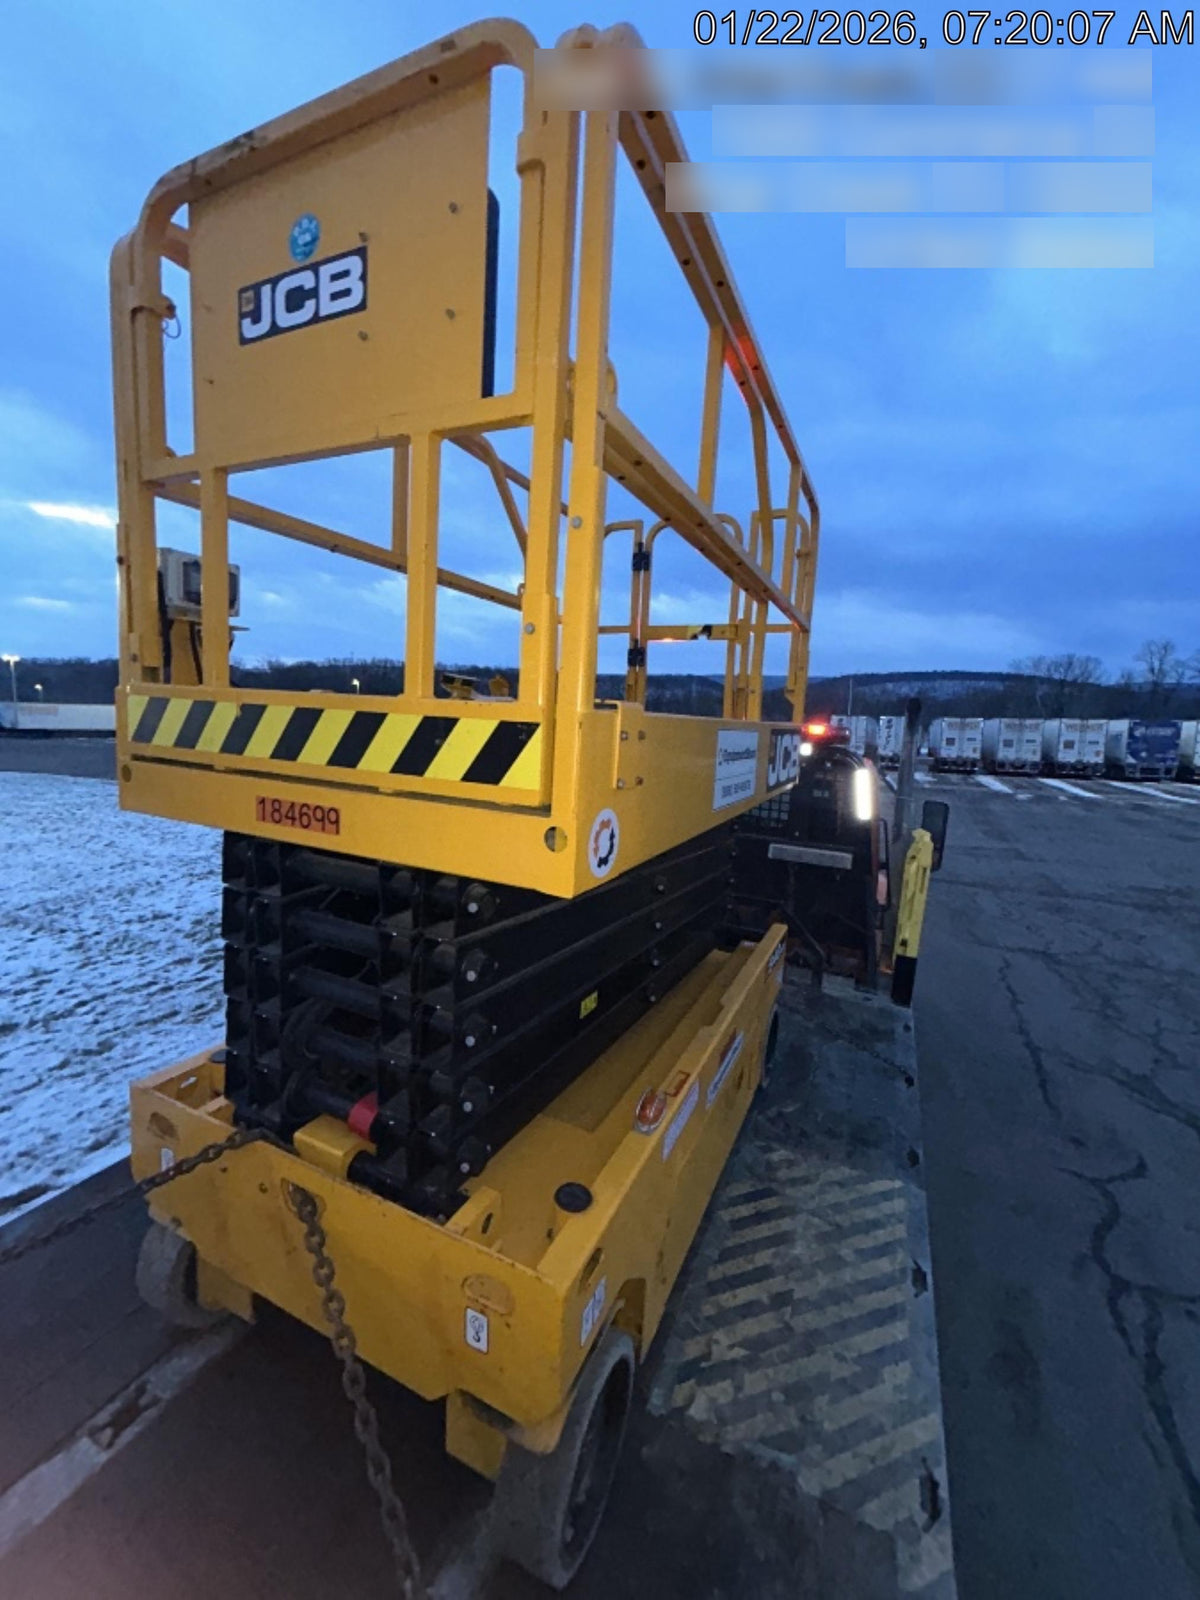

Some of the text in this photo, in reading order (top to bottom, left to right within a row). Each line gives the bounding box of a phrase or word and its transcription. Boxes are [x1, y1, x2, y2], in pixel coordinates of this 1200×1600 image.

[241, 255, 364, 339] JCB
[768, 733, 801, 787] JCB
[258, 797, 340, 835] 184699
